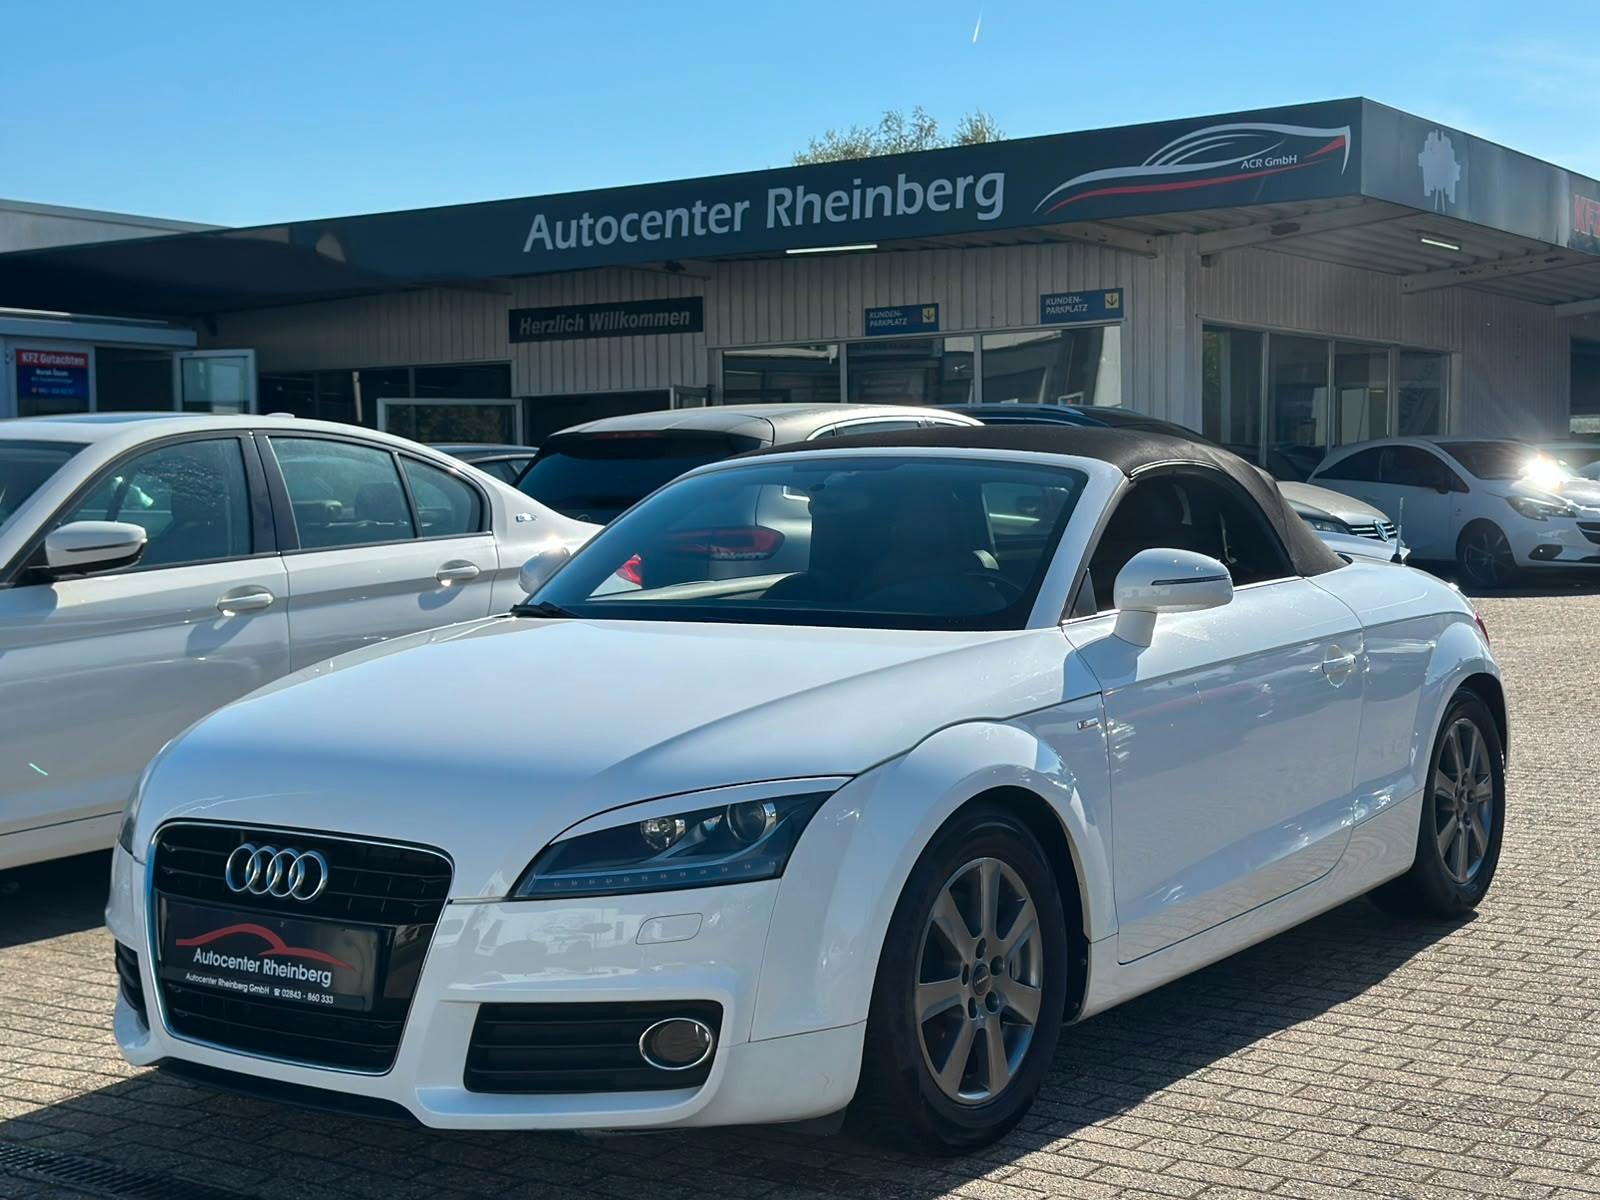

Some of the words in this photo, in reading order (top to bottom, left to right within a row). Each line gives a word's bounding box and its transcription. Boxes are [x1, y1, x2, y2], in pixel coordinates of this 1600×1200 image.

[1240, 159, 1263, 169] ACR
[1265, 155, 1297, 167] GmbH
[523, 200, 750, 253] Autocenter
[766, 172, 1005, 228] Rheinberg
[1045, 295, 1083, 306] KUNDEN-
[1045, 304, 1088, 314] PARKPLATZ
[519, 313, 584, 335] Herzlich
[589, 310, 691, 332] Willkommen
[22, 352, 39, 364] KFZ
[40, 353, 85, 366] Gutachten
[193, 948, 260, 973] Autocenter
[263, 958, 332, 988] Rheinberg
[185, 972, 217, 986] Autocenter
[218, 978, 248, 993] Rheinberg
[249, 983, 270, 995] GmbH
[281, 989, 301, 1000] 02843
[307, 993, 321, 1004] 860
[321, 995, 334, 1005] 333
